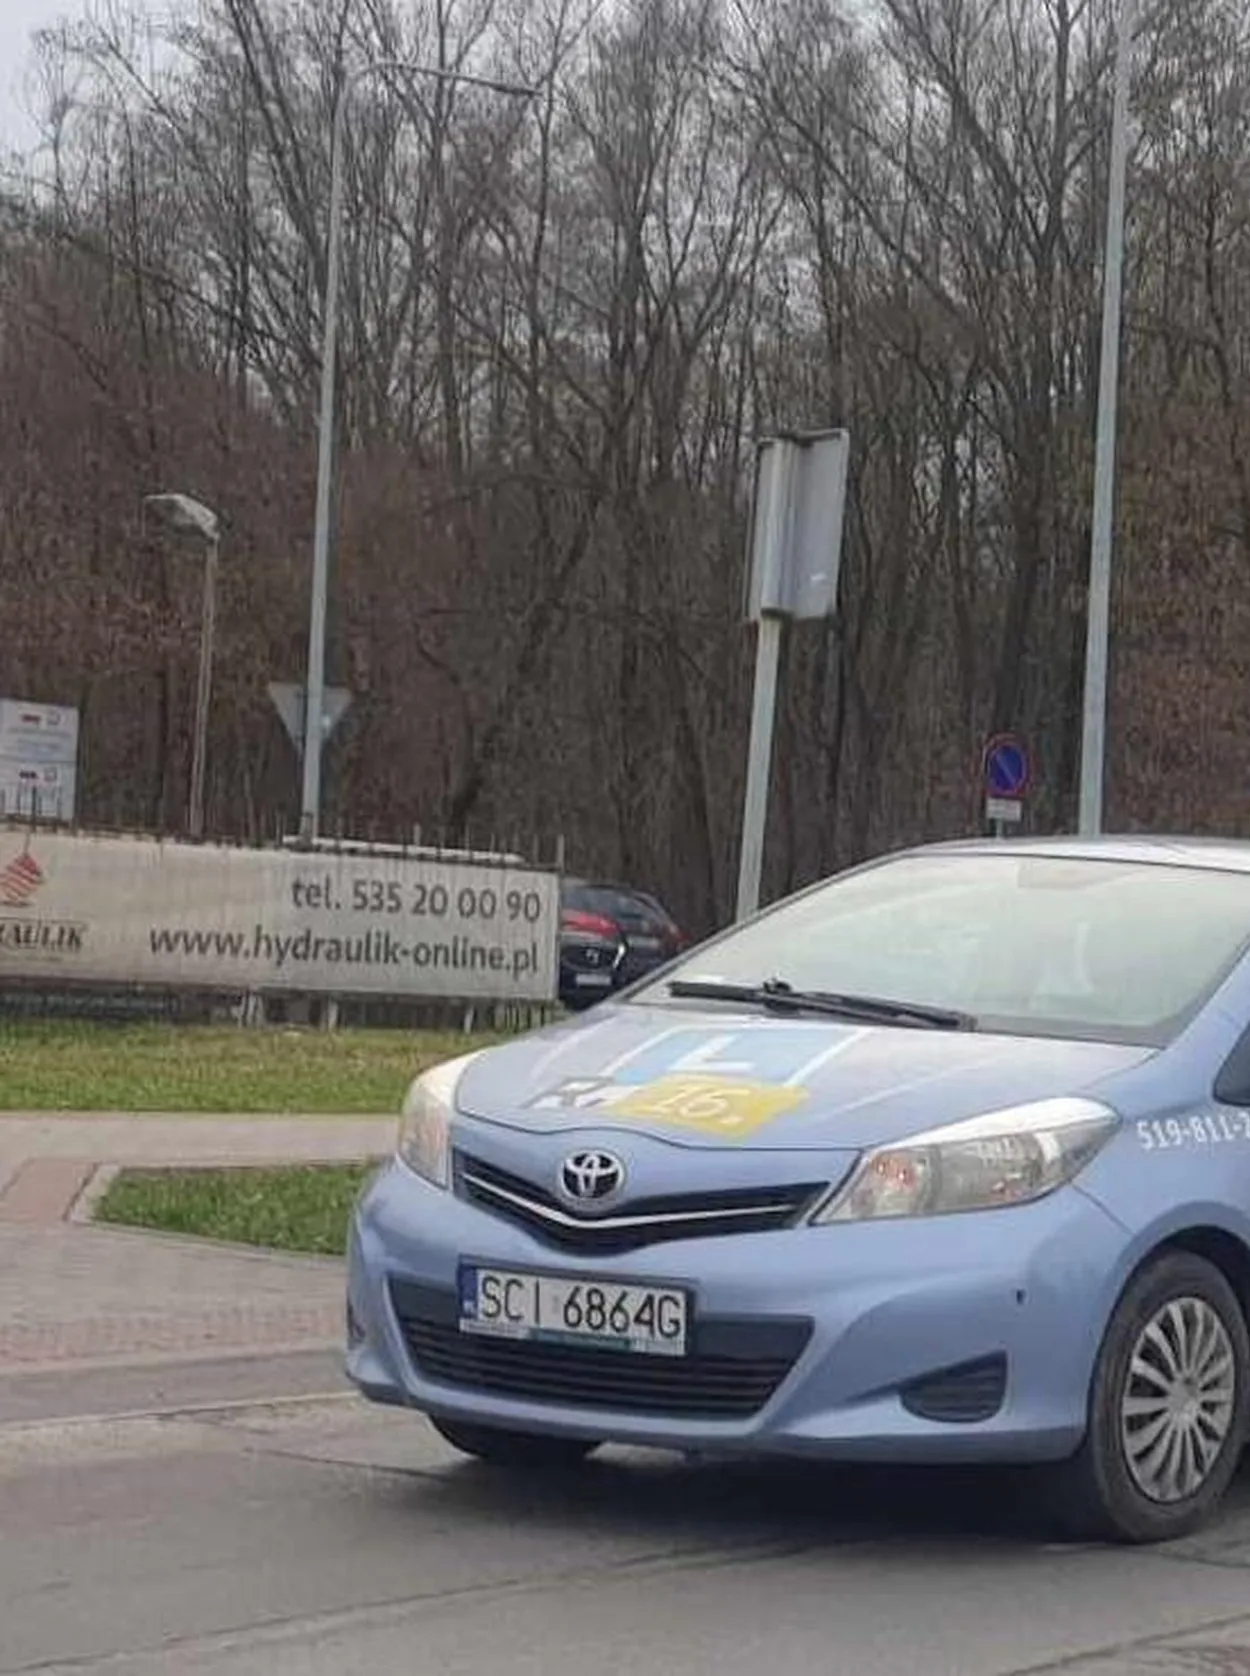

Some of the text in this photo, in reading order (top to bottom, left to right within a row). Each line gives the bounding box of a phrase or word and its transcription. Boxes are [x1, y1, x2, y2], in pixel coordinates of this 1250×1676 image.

[291, 873, 541, 923] tel. 535 20 00 90
[0, 923, 87, 953] AULIK
[150, 924, 538, 982] www.hydraulik-online.pl
[481, 1275, 681, 1339] SCI 6864G
